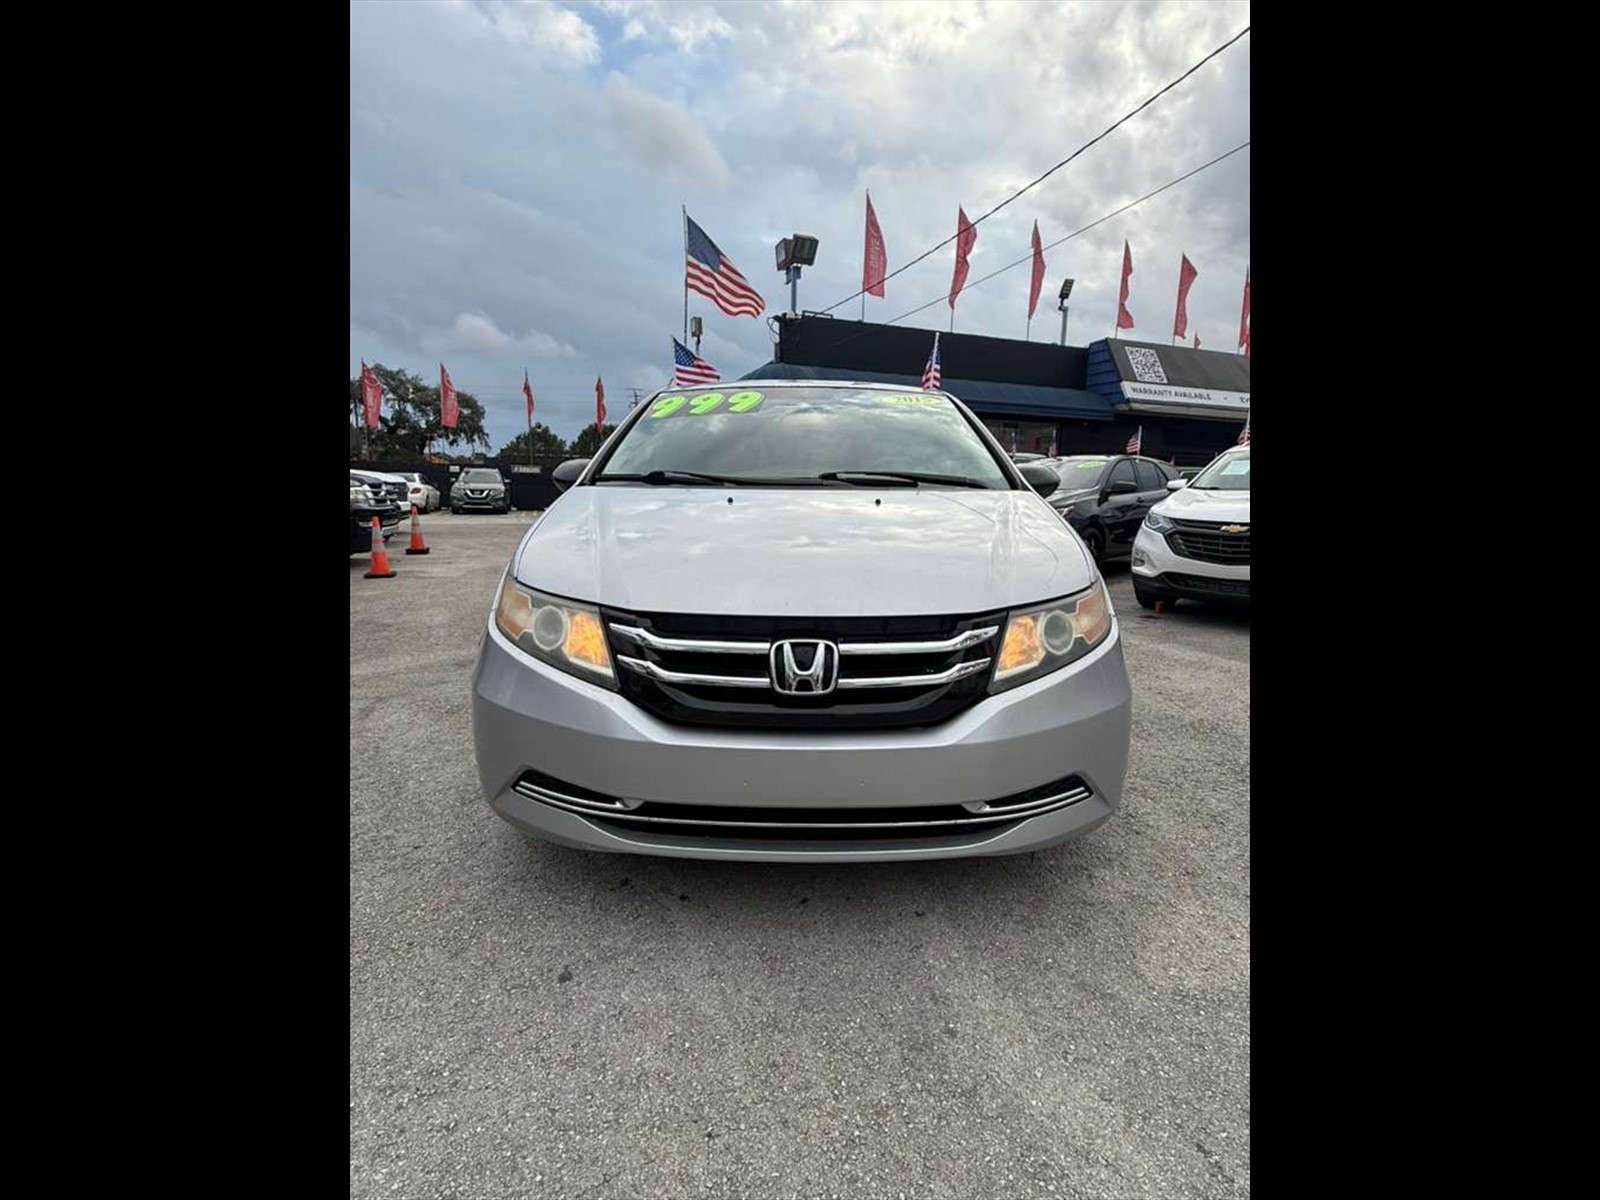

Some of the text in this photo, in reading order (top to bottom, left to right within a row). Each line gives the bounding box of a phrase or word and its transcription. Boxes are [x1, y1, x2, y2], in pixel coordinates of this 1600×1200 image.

[1131, 386, 1212, 401] WARRANTY AVAILABLE
[651, 391, 764, 418] 999
